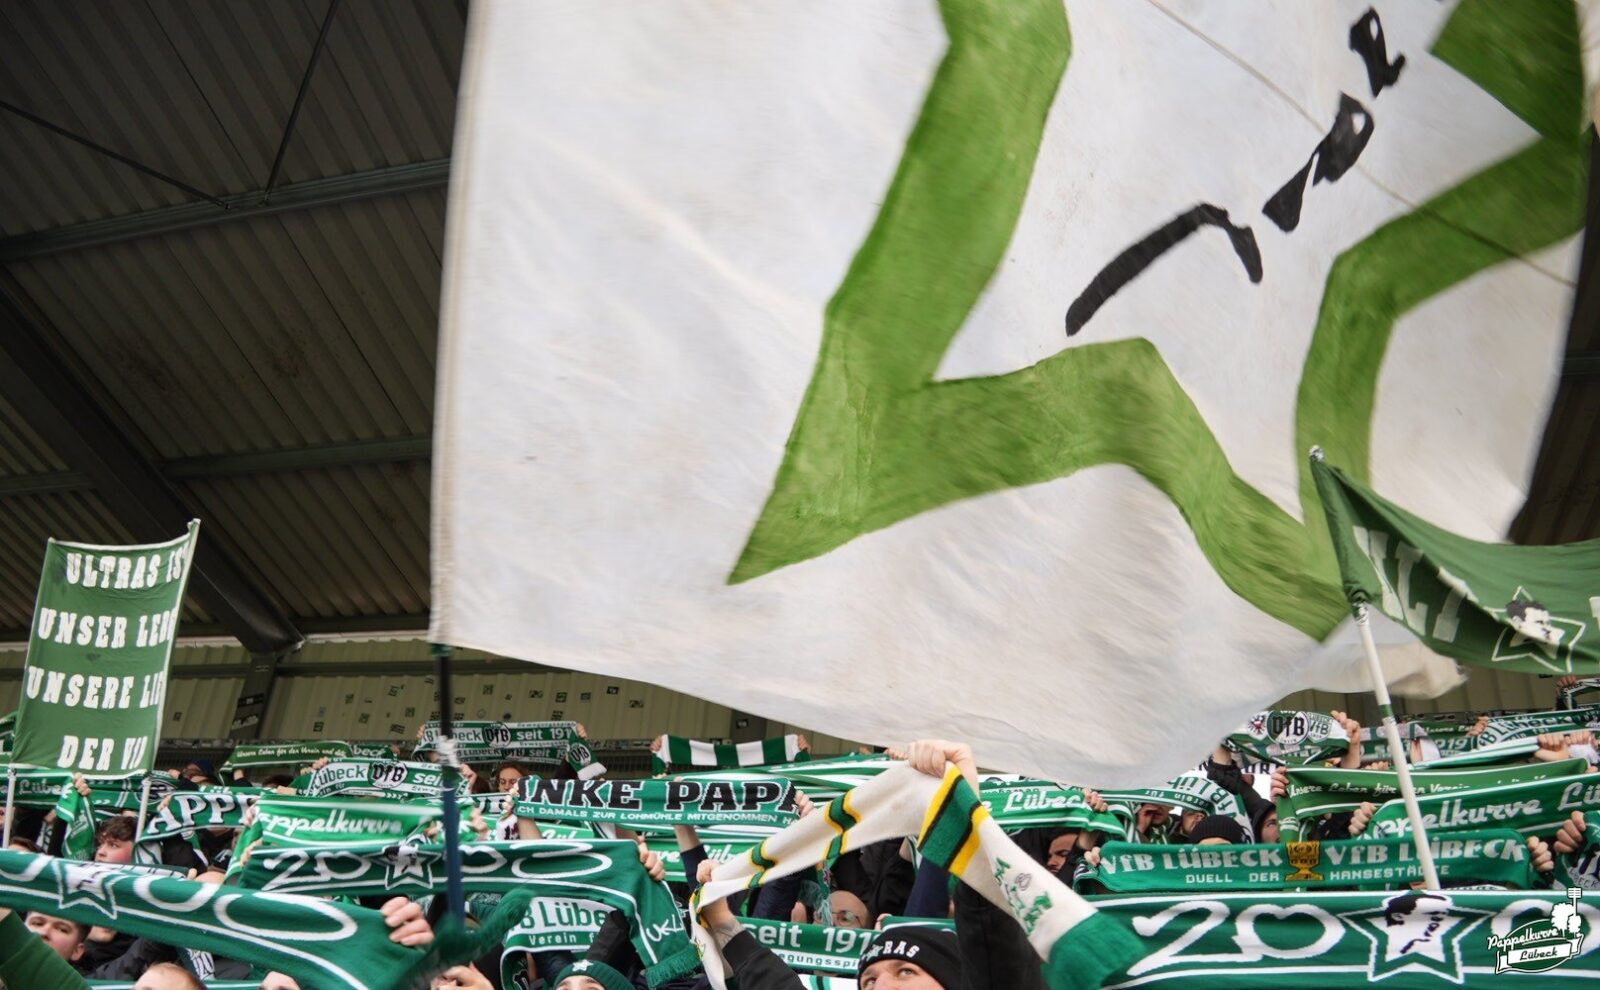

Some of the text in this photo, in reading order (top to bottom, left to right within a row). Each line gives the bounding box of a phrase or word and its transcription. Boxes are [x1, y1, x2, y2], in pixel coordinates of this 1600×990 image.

[66, 552, 161, 590] ULTRAS
[37, 607, 128, 649] UNSER
[26, 665, 134, 710] UNSERE
[517, 728, 543, 740] seit
[57, 735, 115, 771] DER
[664, 780, 801, 814] PAPA
[1373, 783, 1397, 798] für
[539, 807, 588, 818] DAMALS
[593, 811, 616, 820] ZUR
[620, 812, 682, 821] LOHMÜHLE
[687, 813, 778, 823] MITGENOMMEN
[1101, 852, 1155, 875] VfB
[1163, 847, 1283, 870] LÜBECK
[1325, 844, 1388, 866] VfB
[1185, 865, 1450, 884] DUELL DER HANSESTÄE
[529, 933, 577, 946] Verein
[745, 922, 881, 956] seit 191
[1127, 901, 1346, 977] 20
[778, 953, 859, 968] egungsspi
